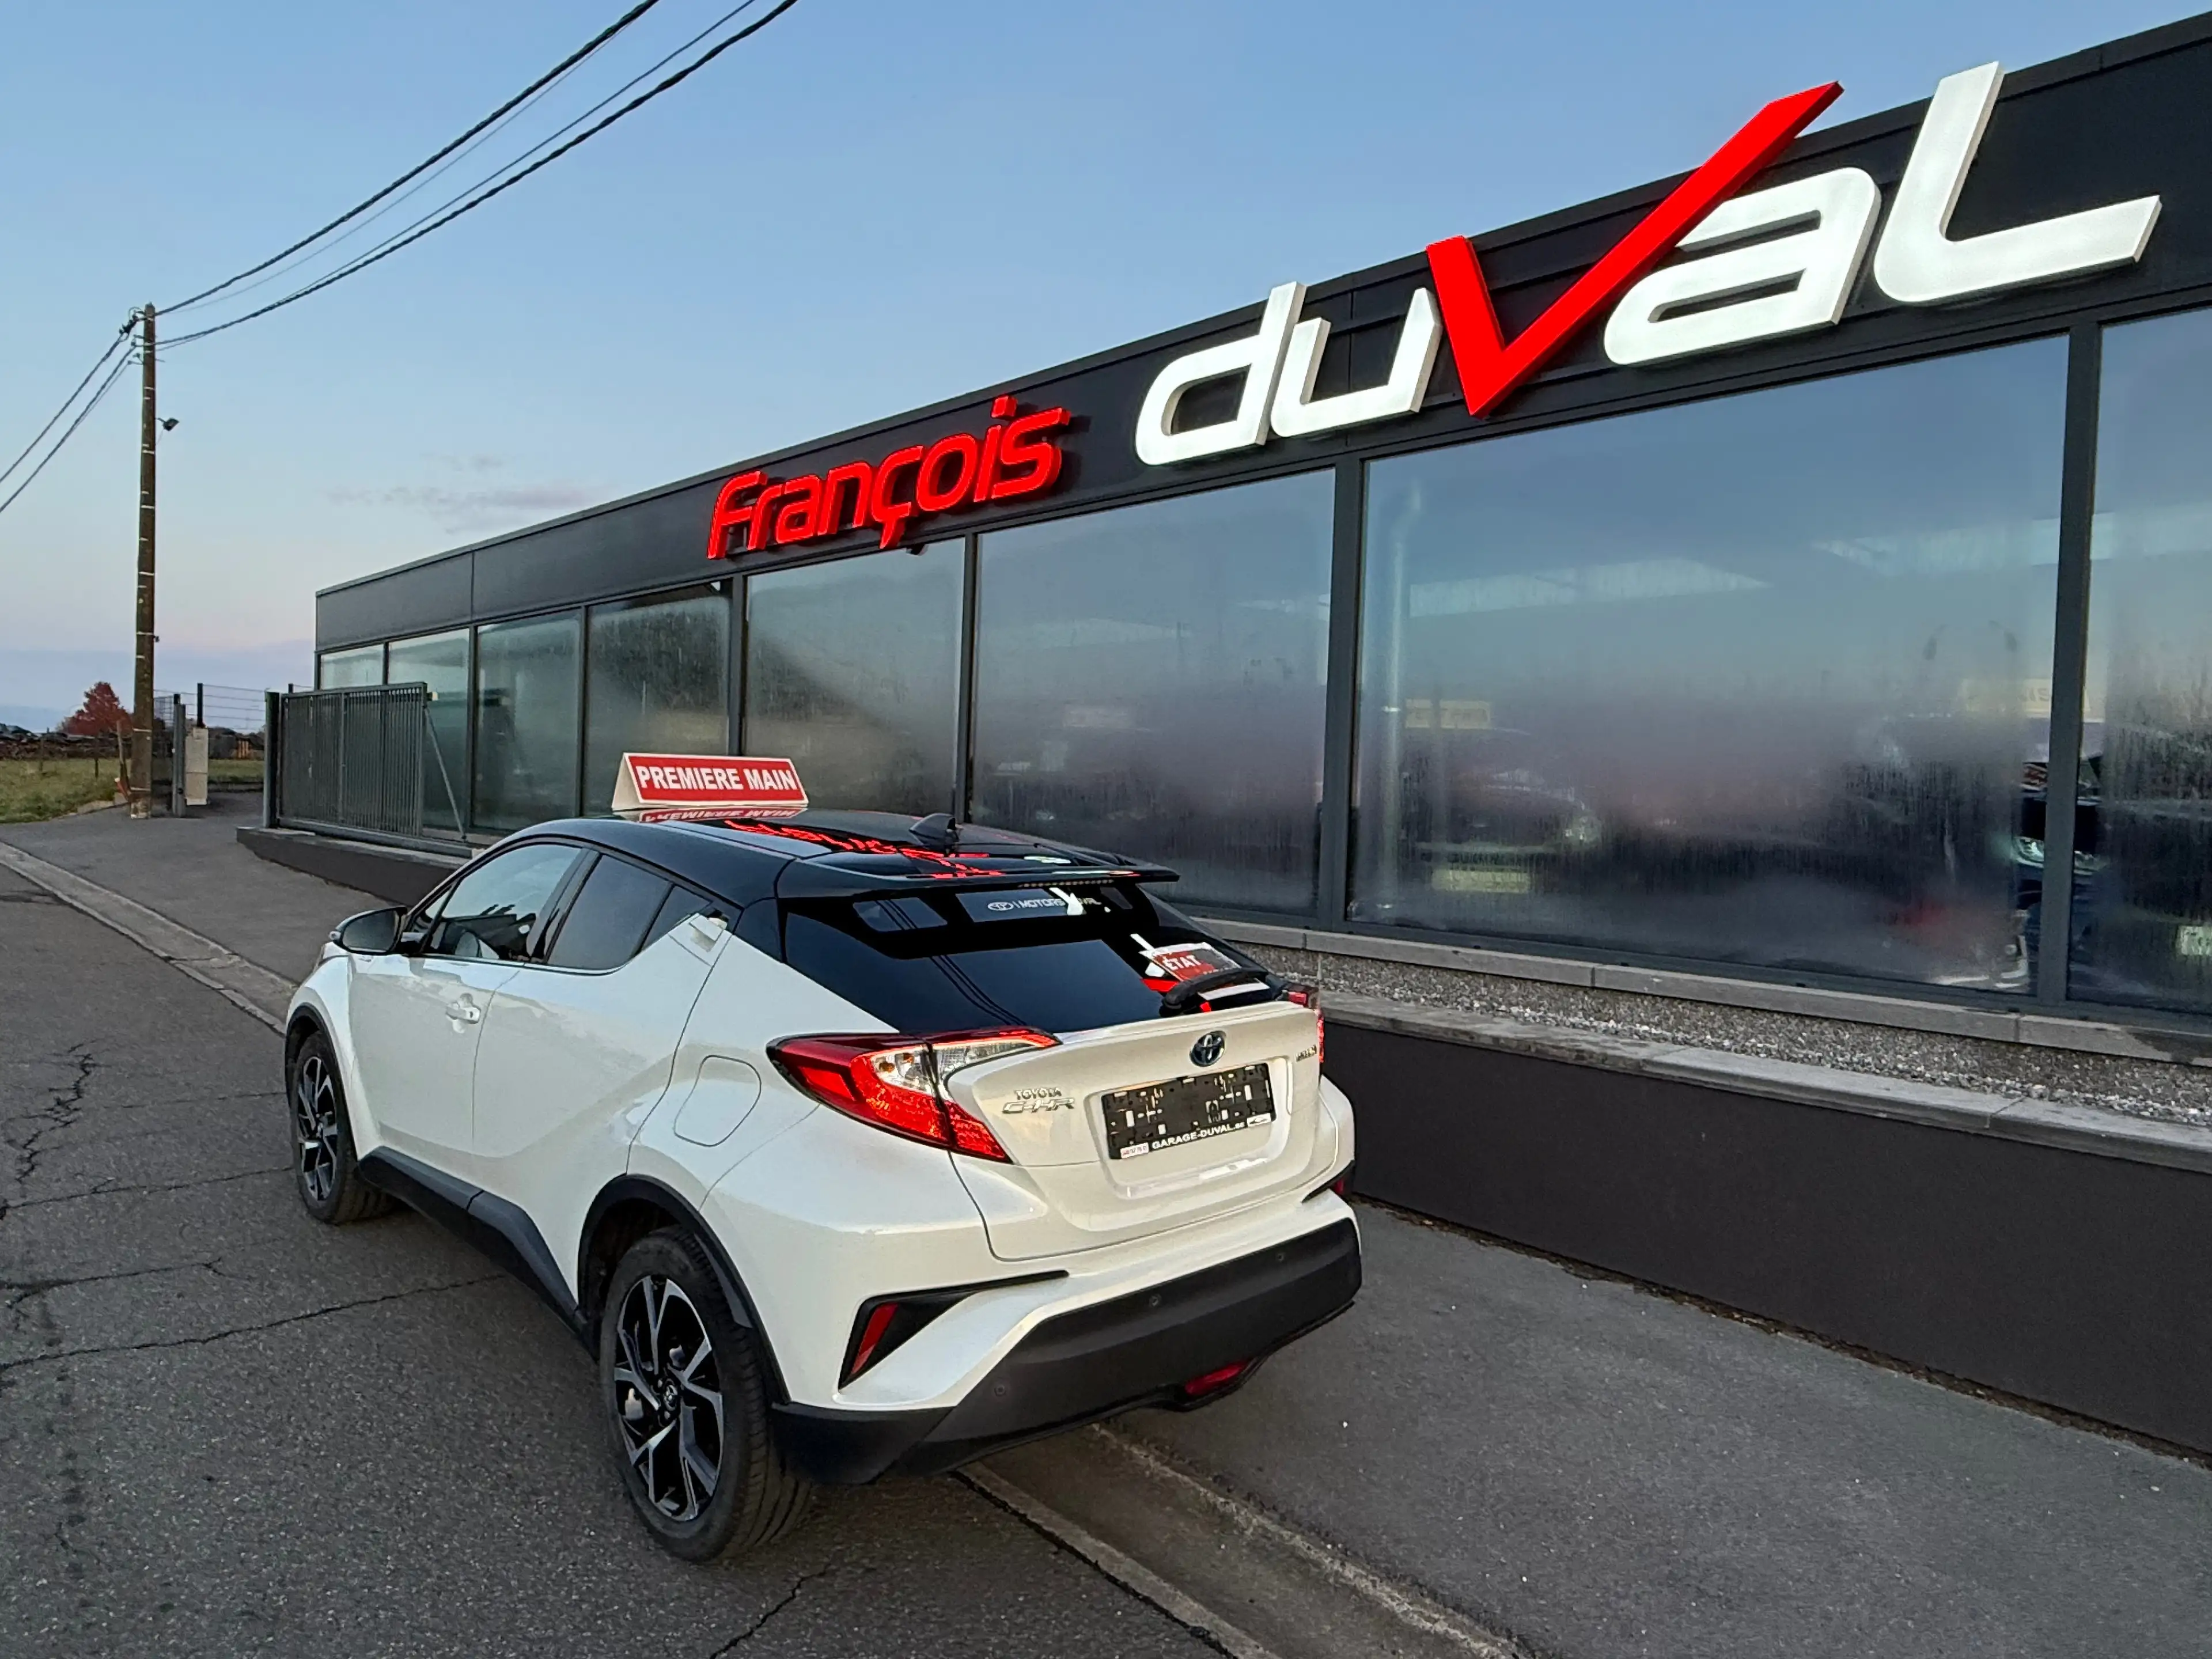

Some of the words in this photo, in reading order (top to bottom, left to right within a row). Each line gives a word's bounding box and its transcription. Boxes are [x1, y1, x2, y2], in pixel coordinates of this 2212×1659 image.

[636, 766, 744, 790] PREMIERE
[744, 769, 797, 790] MAIN
[1014, 1087, 1062, 1100] TOYOTA
[1002, 1097, 1075, 1114] C-HR
